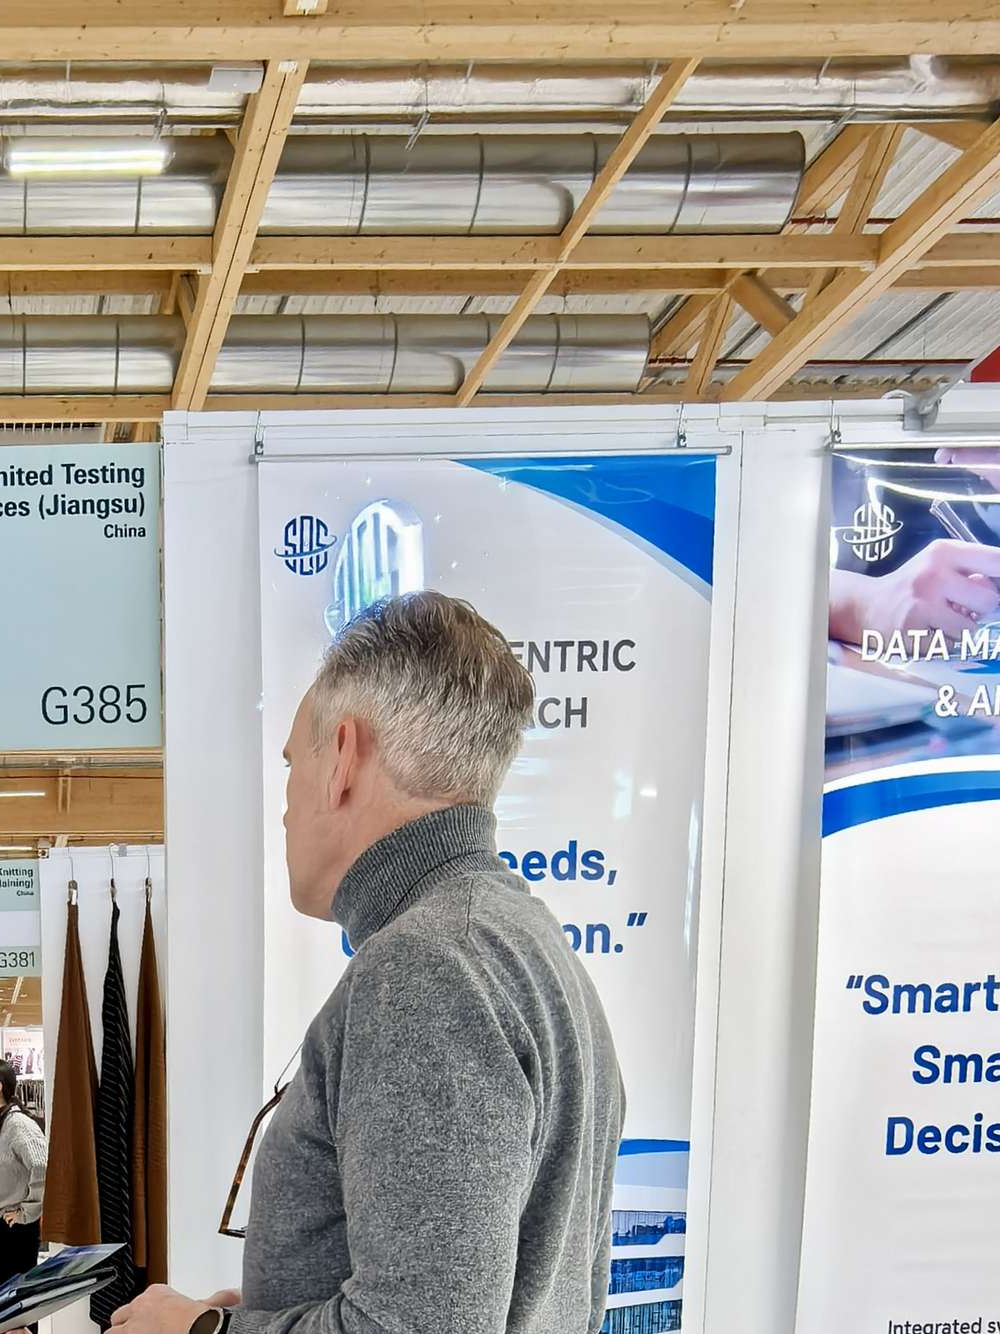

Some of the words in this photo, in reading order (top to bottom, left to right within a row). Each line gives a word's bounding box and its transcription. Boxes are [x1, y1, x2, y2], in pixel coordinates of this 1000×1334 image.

[61, 462, 145, 488] Testing
[38, 492, 146, 520] (Jiangsu)
[103, 524, 146, 538] China
[861, 629, 950, 662] DATA
[41, 684, 147, 725] G385
[935, 684, 959, 718] &
